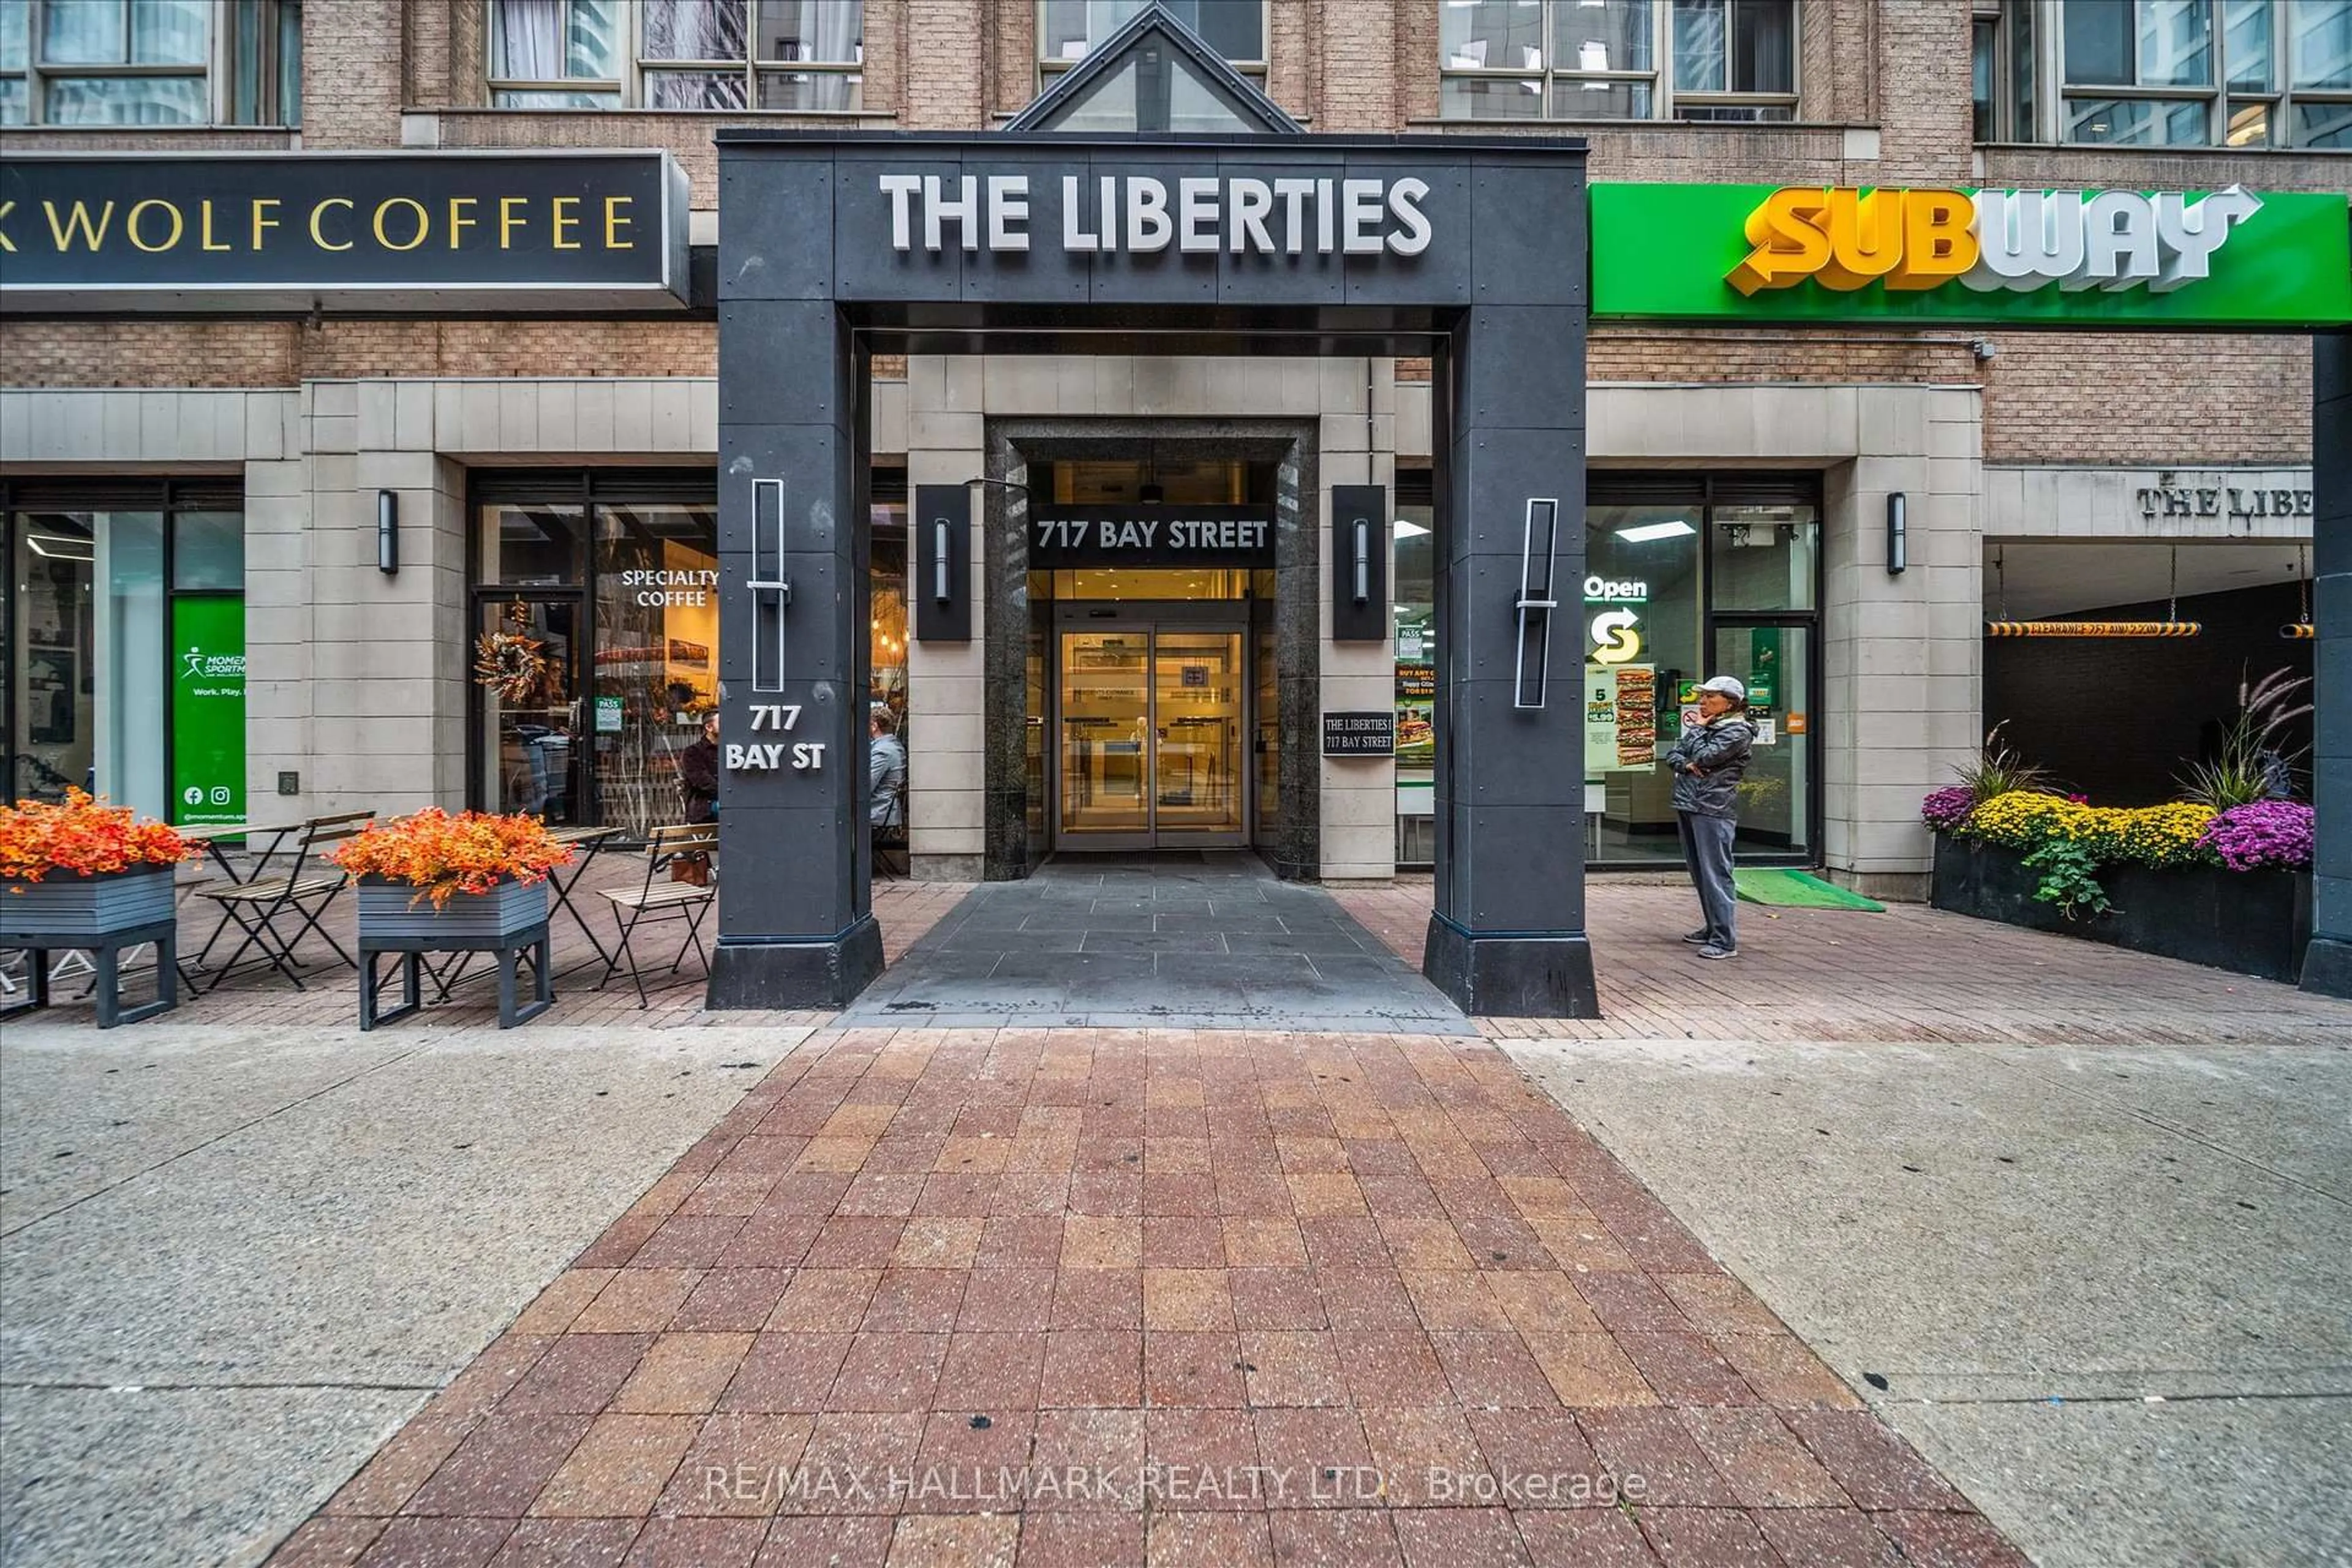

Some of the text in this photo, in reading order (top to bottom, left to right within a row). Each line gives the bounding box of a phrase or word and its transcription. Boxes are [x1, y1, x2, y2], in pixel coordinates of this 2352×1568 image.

[43, 199, 282, 252] WOLF
[309, 197, 634, 251] COFFEE
[880, 175, 1433, 256] THE LIBERTIES
[1724, 185, 2264, 296] SUBWAY
[2136, 489, 2220, 516] THE
[1037, 521, 1268, 548] 717 BAY STREET
[622, 570, 720, 586] SPECIALTY
[1584, 576, 1648, 601] Open
[637, 591, 706, 607] COFFEE
[1401, 629, 1420, 638] PASS
[1596, 688, 1606, 701] 5
[749, 705, 802, 731] 717
[1325, 718, 1344, 731] THE
[1344, 718, 1387, 731] LIBERTIES
[1326, 736, 1392, 748] 717 BAY STREET
[725, 743, 826, 769] BAY ST
